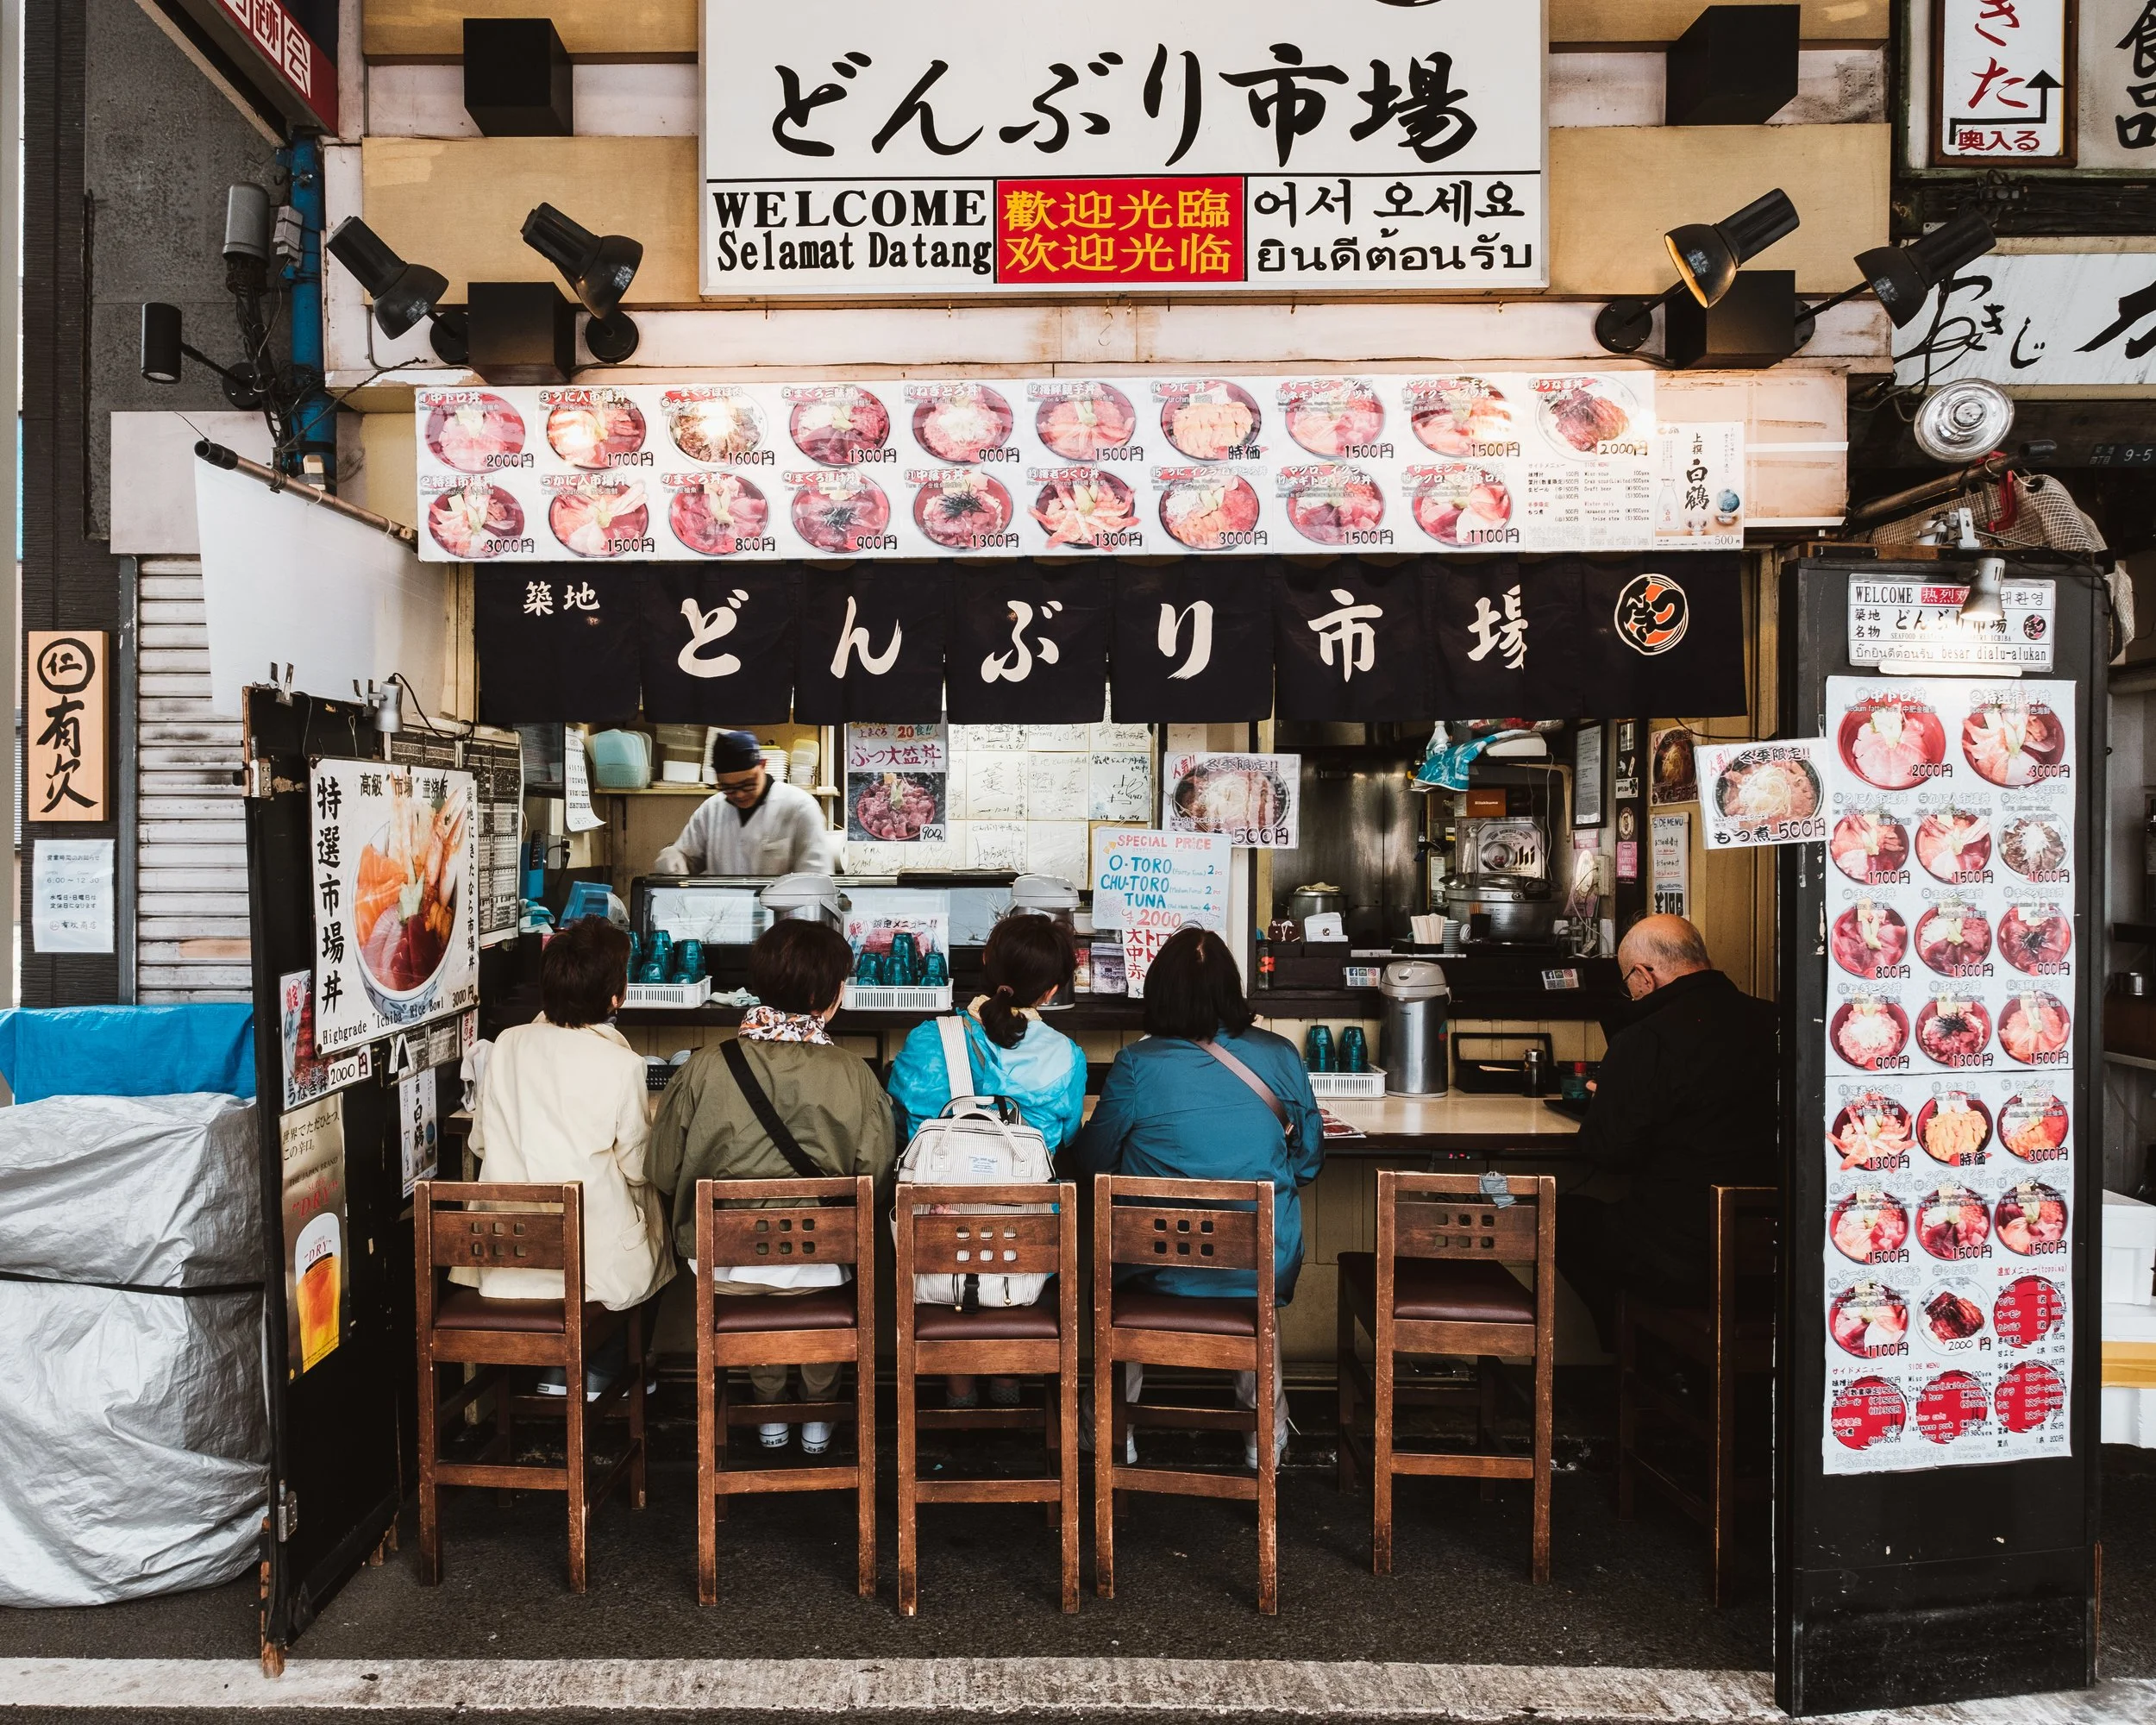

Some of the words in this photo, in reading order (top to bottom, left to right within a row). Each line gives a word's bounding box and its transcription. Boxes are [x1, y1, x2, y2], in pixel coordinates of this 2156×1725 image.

[774, 42, 1478, 167] どんぶり市場
[1958, 130, 2040, 152] 奥入る
[1255, 180, 1351, 219] 어서
[1374, 180, 1524, 220] 오세요
[716, 188, 987, 229] WELCOME
[1004, 187, 1231, 230] 歡迎光臨
[718, 231, 855, 273] Selamat
[868, 232, 993, 275] Datang
[1003, 232, 1231, 275] 欢迎光临
[1255, 228, 1533, 273] ยินดีต้อนรับ
[1344, 443, 1395, 459] 1500円
[1471, 442, 1521, 458] 1500円
[1600, 442, 1648, 456] 2000円
[1693, 432, 1703, 455] 上撰
[486, 453, 535, 468] 2000円
[607, 451, 654, 467] 1700円
[727, 450, 775, 466] 1600円
[849, 448, 897, 464] 1300円
[978, 448, 1020, 463] 900円
[1095, 446, 1144, 461] 1500円
[1228, 445, 1261, 460] 時価
[2124, 448, 2153, 461] 9-5
[1684, 458, 1709, 511] 白鶴
[607, 536, 655, 553] 1500円
[735, 536, 775, 552] 800円
[856, 534, 898, 550] 900円
[971, 532, 1019, 549] 1300円
[1094, 531, 1143, 548] 1300円
[1219, 530, 1268, 546] 3000円
[1344, 530, 1395, 545] 1500円
[1470, 528, 1520, 545] 1100円
[486, 537, 535, 554] 3000円
[523, 581, 601, 617] 築地
[1855, 586, 1914, 605] WELCOME
[1855, 609, 1881, 621] 築地
[677, 585, 1525, 684] どんぶり市場
[1855, 625, 1881, 638] 名物
[1941, 644, 1971, 660] besar
[46, 652, 84, 677] 仁
[857, 728, 888, 738] 上まぐろ
[35, 695, 99, 813] 有次
[850, 743, 942, 768] ぶつ大盛丼
[1739, 747, 1810, 763] 冬季限定!!
[1912, 763, 1953, 778] 2000円
[2030, 763, 2071, 779] 3000円
[1233, 827, 1288, 845] 500円
[1714, 826, 1771, 844] もつ煮
[1778, 818, 1826, 840] 500円
[1117, 834, 1168, 849] SPECIAL
[1207, 864, 1214, 875] 2
[1868, 869, 1910, 885] 1700円
[1953, 869, 1994, 885] 1500円
[2029, 869, 2070, 884] 1600円
[317, 776, 345, 1015] 特選市場丼
[1205, 886, 1212, 894] 2
[1124, 893, 1167, 909] TUNA
[1202, 903, 1211, 912] 4
[1126, 928, 1172, 947] 大トロ
[1128, 963, 1145, 981] 赤
[1875, 963, 1911, 980] 800円
[1952, 963, 1994, 978] 1300円
[2037, 961, 2071, 976] 900円
[323, 1021, 367, 1045] Highgrade
[410, 1003, 426, 1019] Rice
[429, 998, 444, 1013] Bowl
[1875, 1054, 1909, 1070] 900円
[1952, 1052, 1994, 1068] 1300円
[2029, 1051, 2069, 1065] 1500円
[287, 1079, 329, 1106] うなぎ丼
[283, 1110, 340, 1145] 世界でただひとつ、
[283, 1139, 317, 1161] この辛口。
[2028, 1147, 2068, 1163] 3000円
[1868, 1154, 1909, 1170] 1300円
[1959, 1152, 1986, 1166] 時価
[289, 1174, 301, 1188] THE
[302, 1165, 319, 1181] JAPAN
[320, 1156, 339, 1172] BRAND
[1952, 1245, 1992, 1260] 1500円
[2028, 1240, 2067, 1255] 1500円
[1868, 1248, 1909, 1264] 1500円
[1868, 1341, 1909, 1358] 1100円
[1833, 1366, 1883, 1376] サイドメニュー
